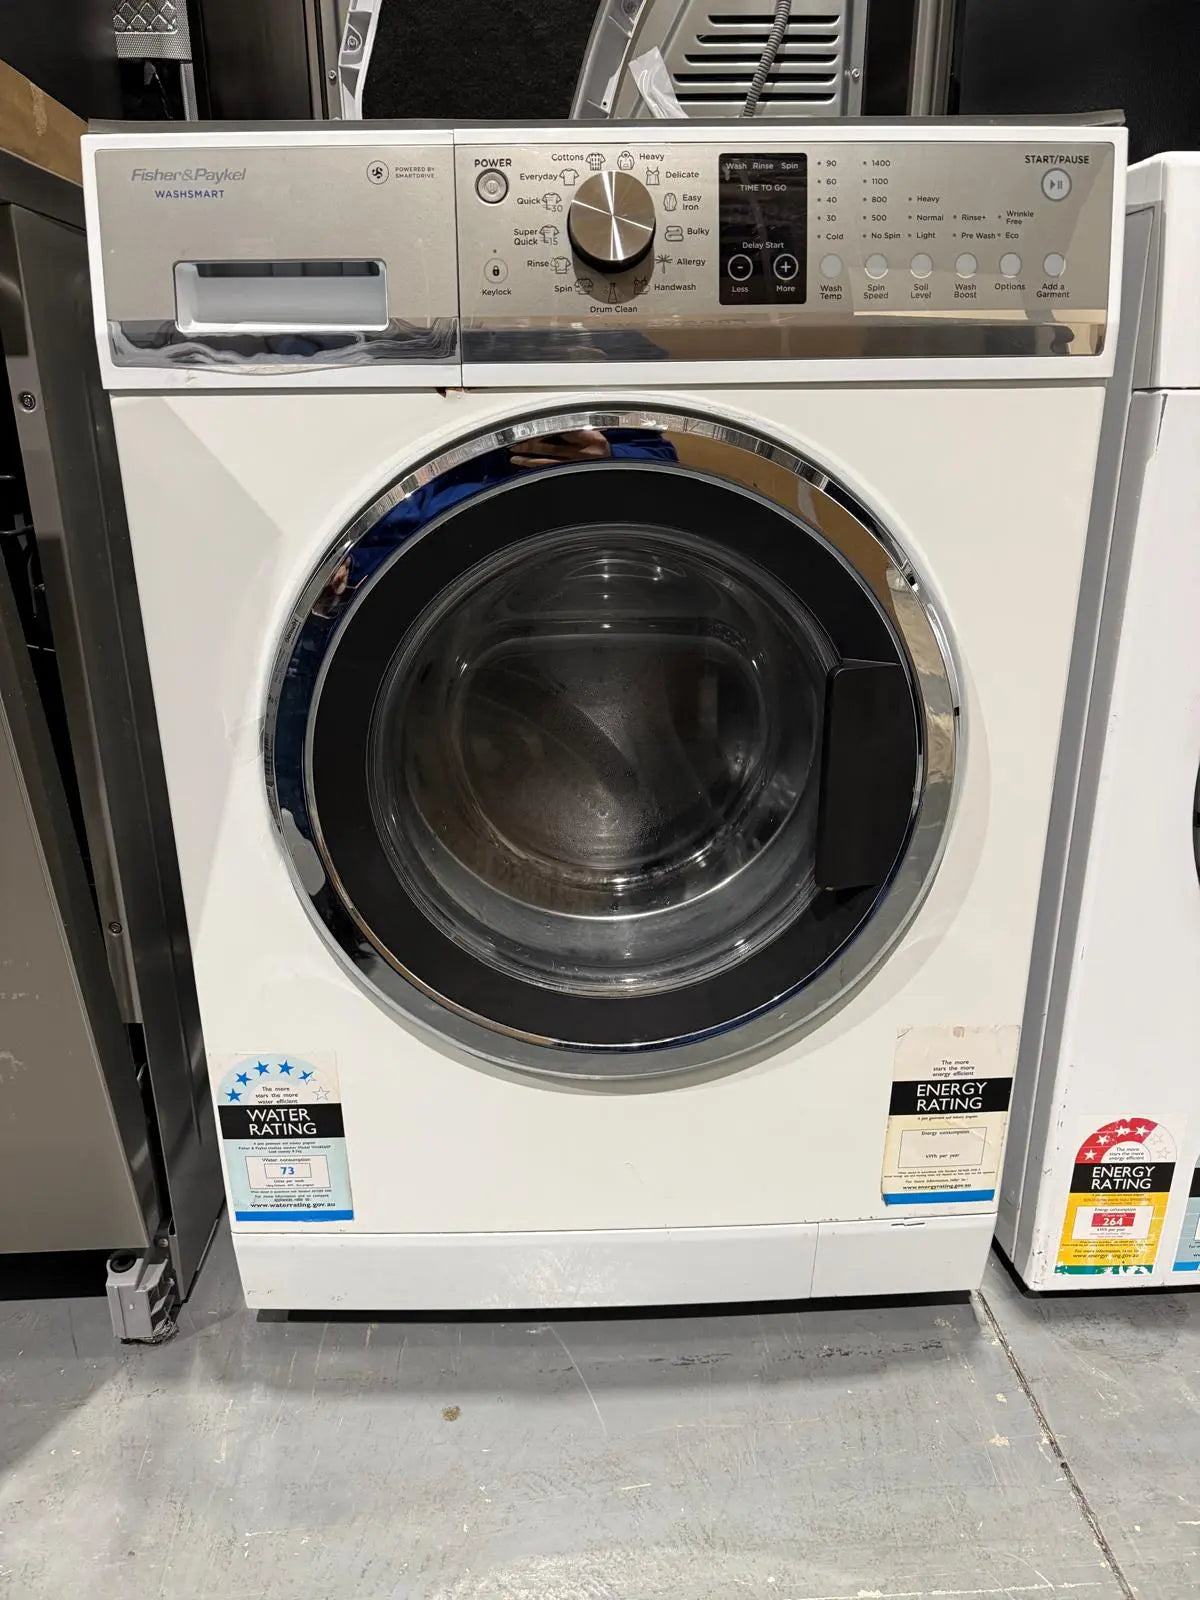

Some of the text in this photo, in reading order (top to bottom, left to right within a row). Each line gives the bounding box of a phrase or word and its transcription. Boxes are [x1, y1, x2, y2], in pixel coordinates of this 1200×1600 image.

[551, 153, 584, 162] Cottons
[639, 153, 664, 162] Heavy
[1024, 155, 1089, 164] START/PAUSE
[474, 158, 512, 168] POWER
[781, 162, 798, 171] Spin
[520, 173, 558, 182] Everyday
[666, 170, 700, 179] Delicate
[155, 190, 224, 199] WASHSMART
[682, 194, 702, 203] Easy
[517, 198, 541, 206] Quick
[551, 205, 563, 213] 30
[514, 228, 538, 237] Super
[687, 228, 710, 236] Bulky
[916, 232, 936, 240] Light
[514, 238, 538, 246] Quick
[742, 242, 763, 250] Delay
[527, 260, 550, 268] Rinse
[676, 258, 706, 267] Allergy
[554, 284, 572, 294] Spin
[654, 283, 696, 291] Handwash
[994, 283, 1026, 291] Options
[482, 288, 512, 296] Keylock
[916, 1082, 988, 1096] ENERGY
[916, 1097, 982, 1111] RATING
[246, 1108, 310, 1122] WATER
[249, 1122, 317, 1135] RATING
[280, 1167, 295, 1175] 73
[1092, 1166, 1156, 1178] ENERGY
[1091, 1178, 1152, 1190] RATING
